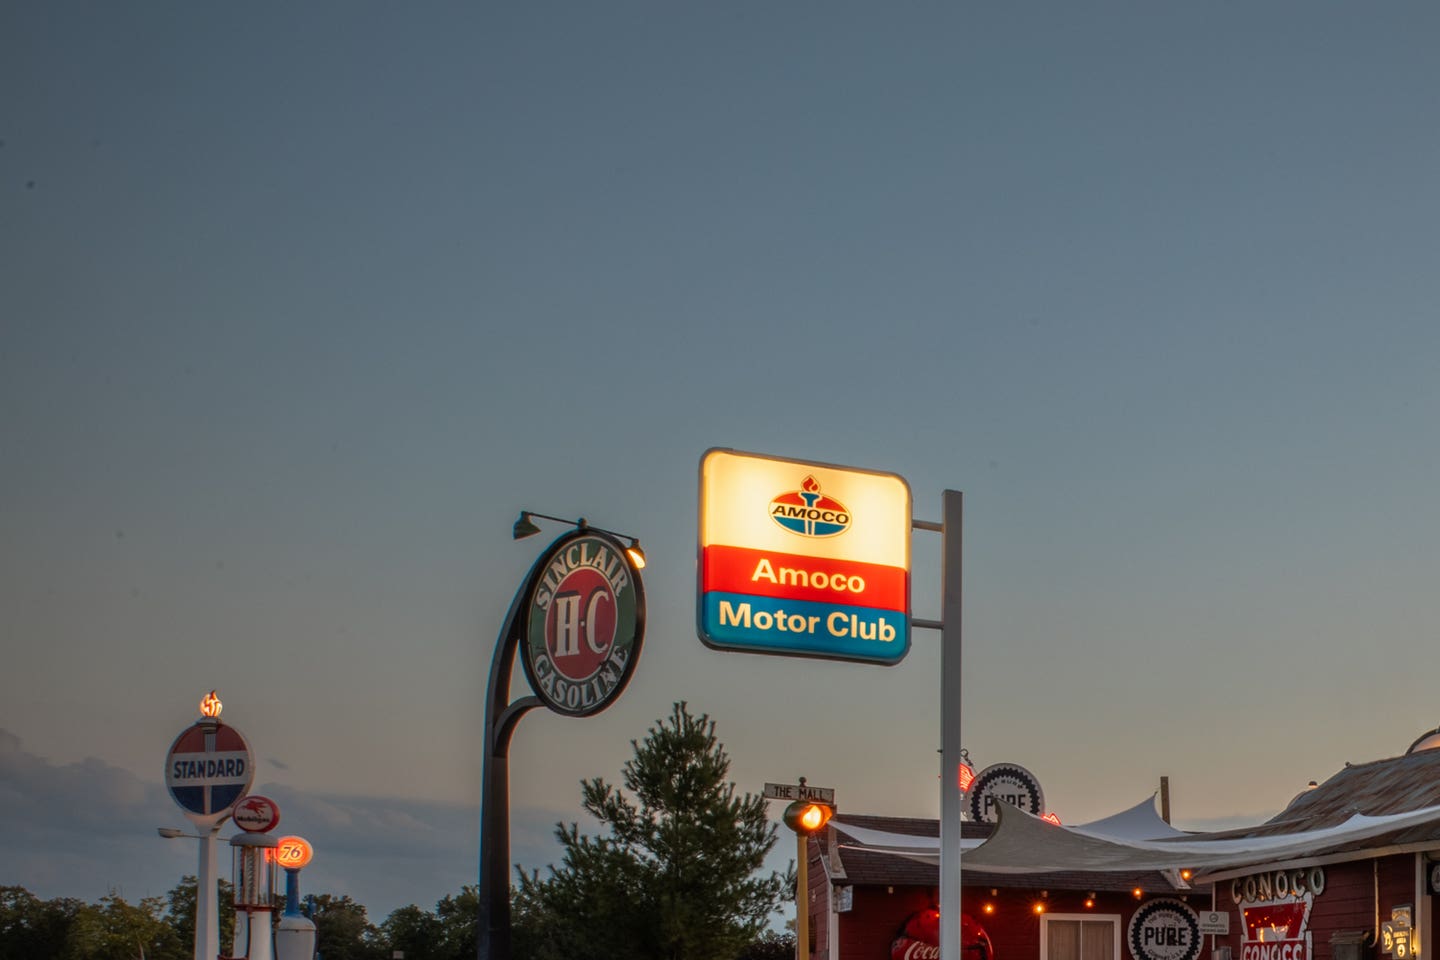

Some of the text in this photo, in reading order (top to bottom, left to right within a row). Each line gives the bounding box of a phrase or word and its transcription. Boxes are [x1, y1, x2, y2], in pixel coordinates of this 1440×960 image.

[772, 505, 849, 524] AMOCO
[536, 543, 629, 612] SINCLAIR
[752, 558, 865, 593] Amoco
[719, 600, 896, 642] Motor Club
[534, 645, 629, 708] GASOLINE
[173, 758, 245, 779] STANDARD
[774, 785, 826, 802] THE MALL
[984, 795, 1026, 816] PRE
[281, 845, 302, 859] 76
[1231, 867, 1325, 905] CONOCO
[1144, 927, 1188, 946] PURE
